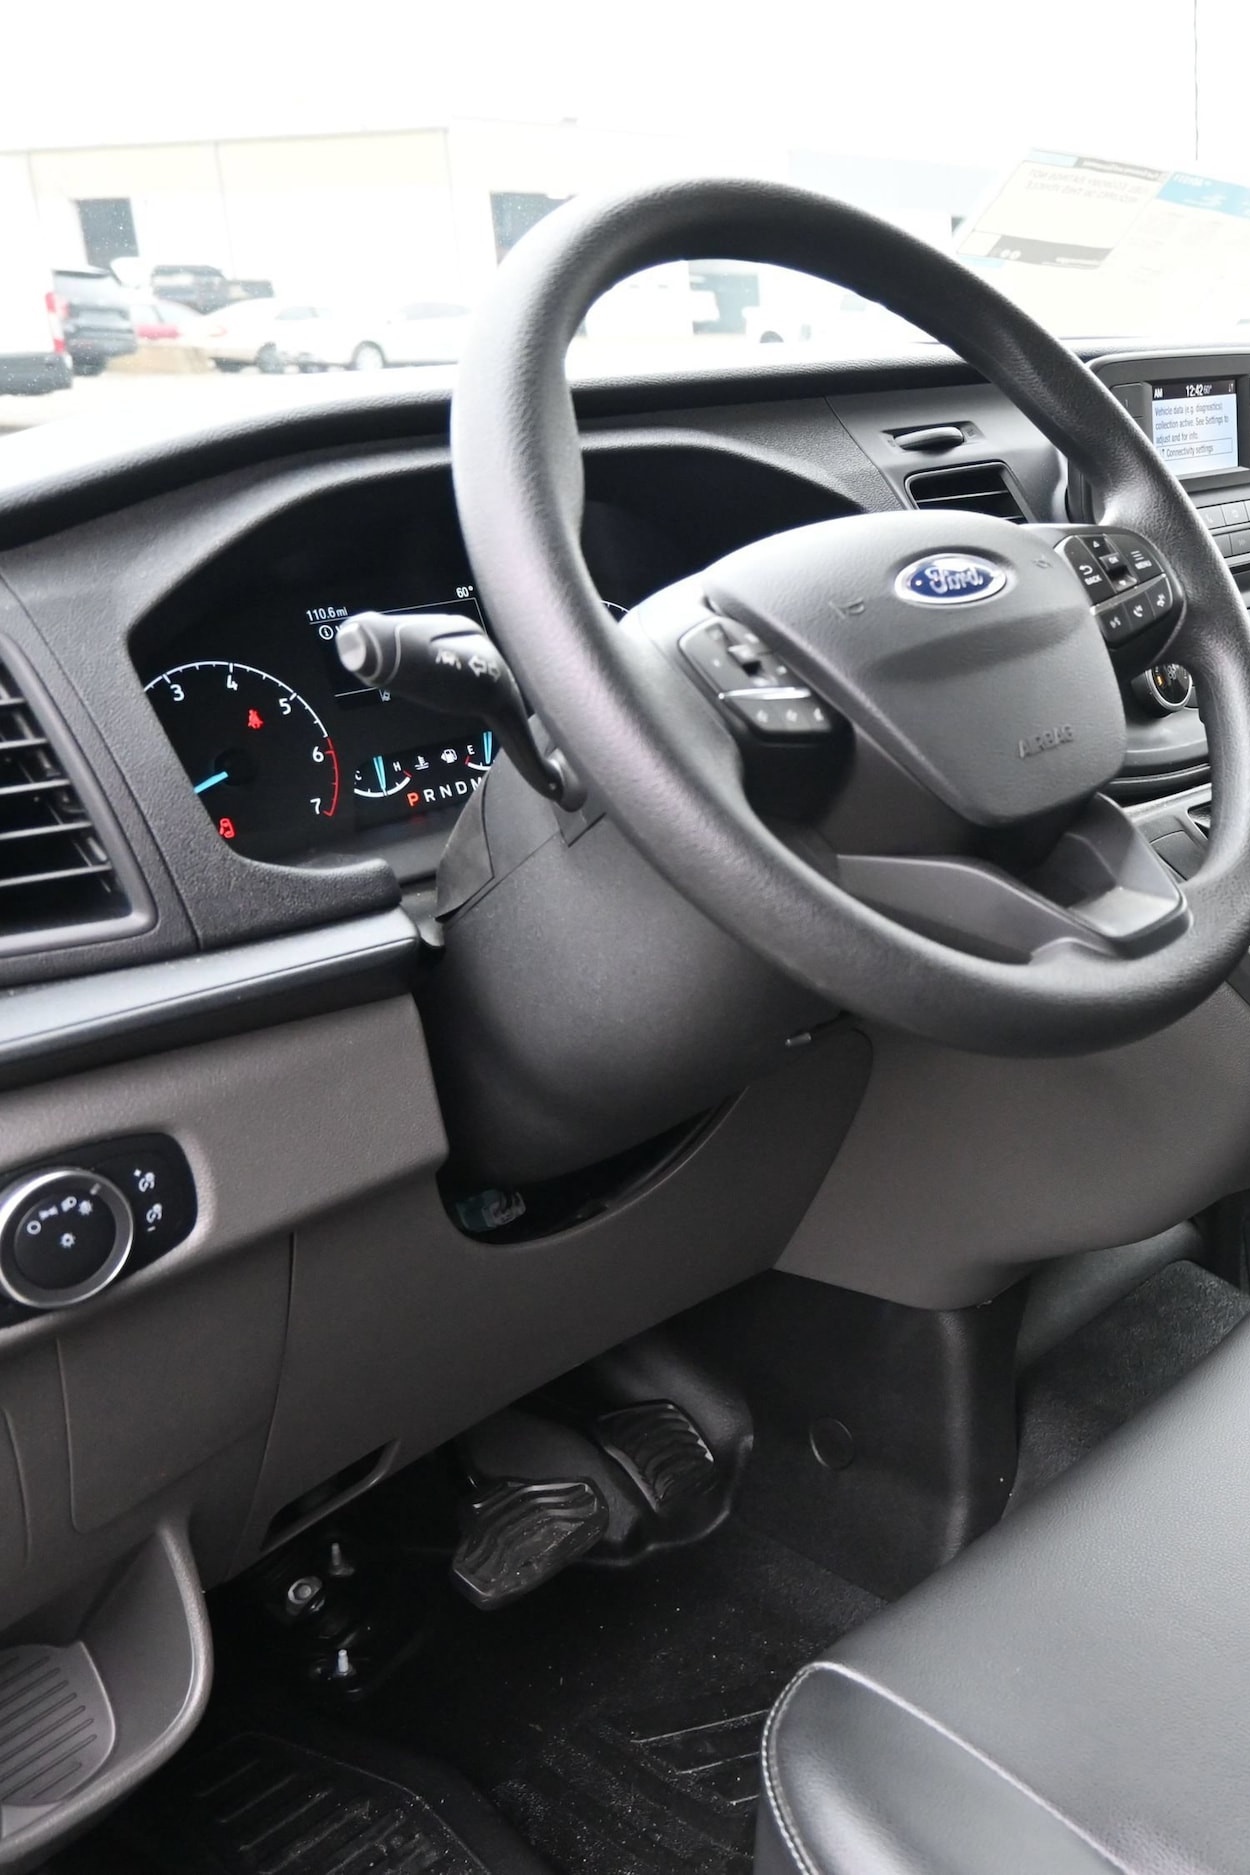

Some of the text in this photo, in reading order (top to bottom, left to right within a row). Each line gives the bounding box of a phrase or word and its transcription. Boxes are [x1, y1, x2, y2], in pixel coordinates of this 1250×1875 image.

[1154, 388, 1163, 398] AM
[1186, 384, 1203, 397] 12:42
[1155, 405, 1172, 416] Vehicle
[1155, 419, 1178, 430] collection
[1195, 416, 1204, 426] See
[227, 674, 238, 691] 4
[170, 684, 185, 701] 3
[278, 698, 292, 715] 5
[312, 746, 325, 763] 6
[467, 744, 475, 756] E
[393, 761, 401, 772] H
[310, 797, 321, 815] 7
